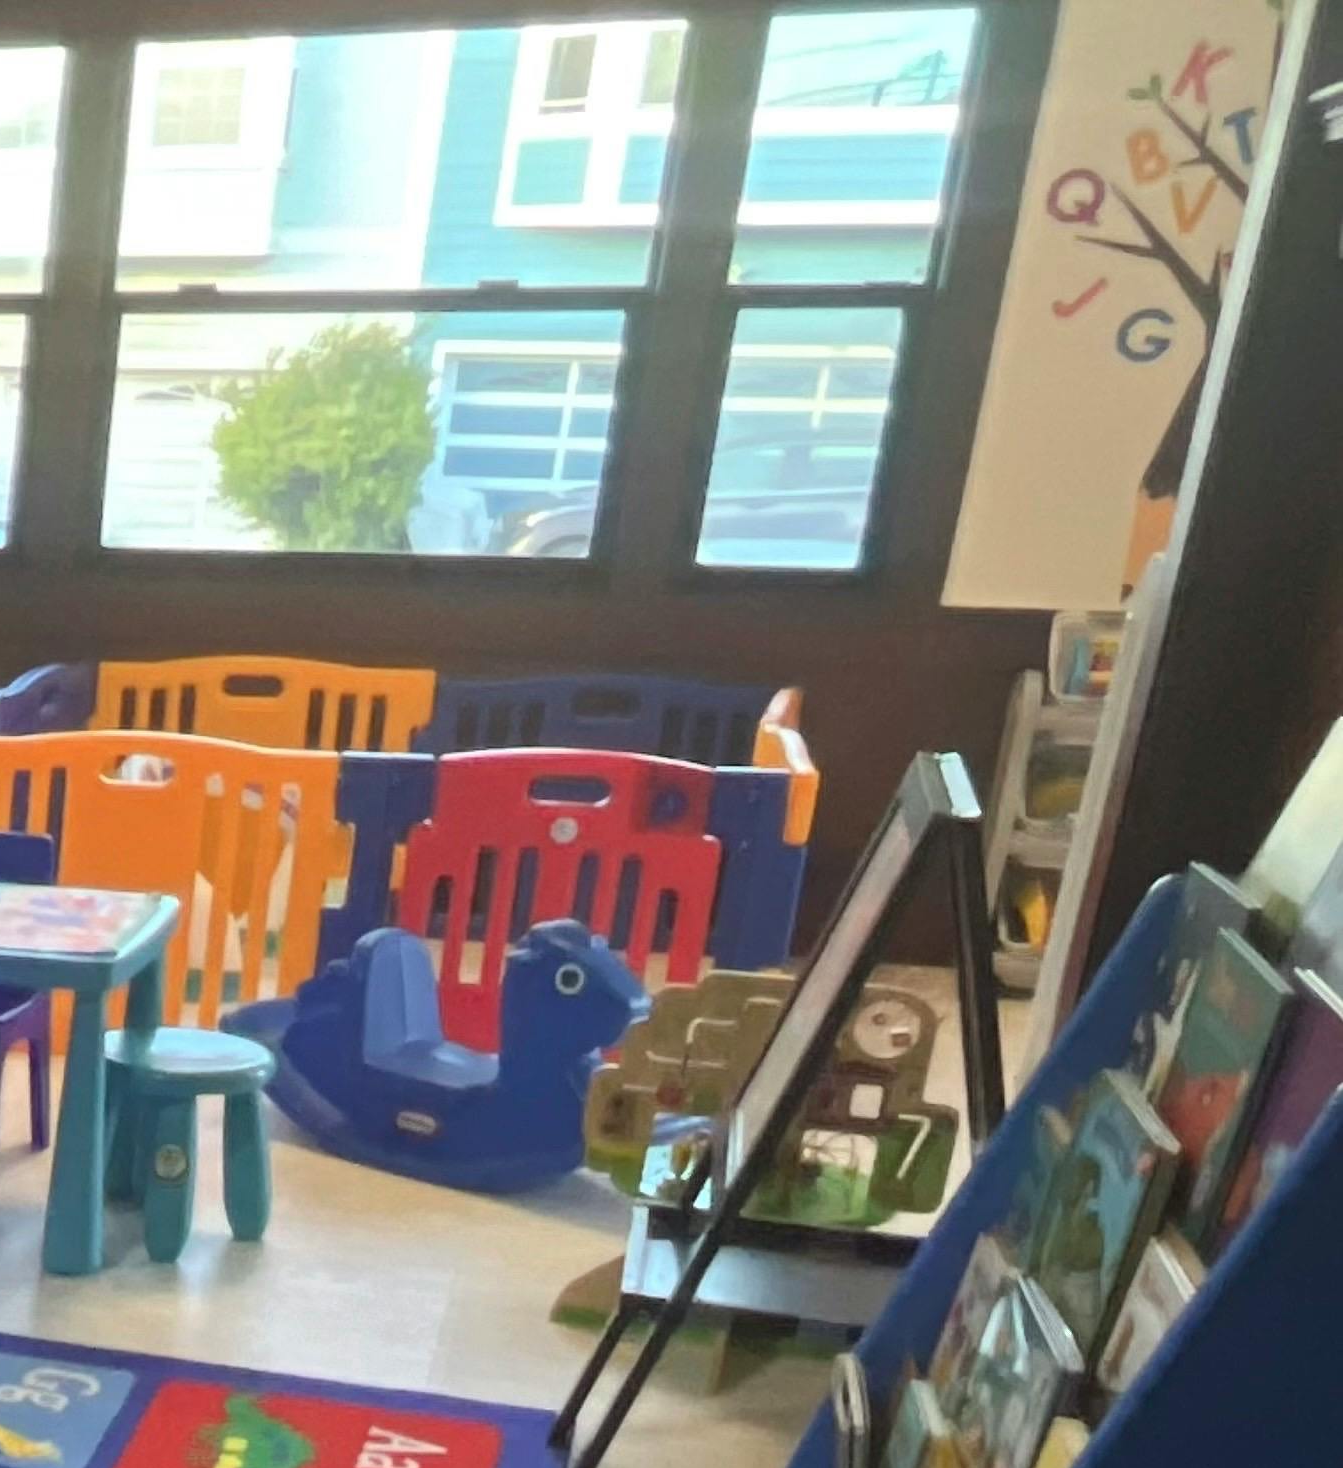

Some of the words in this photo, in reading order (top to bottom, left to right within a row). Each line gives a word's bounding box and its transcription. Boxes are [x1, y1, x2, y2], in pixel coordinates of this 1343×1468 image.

[1172, 38, 1234, 102] K
[1126, 128, 1169, 185] B
[1223, 107, 1258, 163] T
[1047, 169, 1106, 226] Q
[1171, 180, 1217, 233] V
[1116, 308, 1174, 362] G
